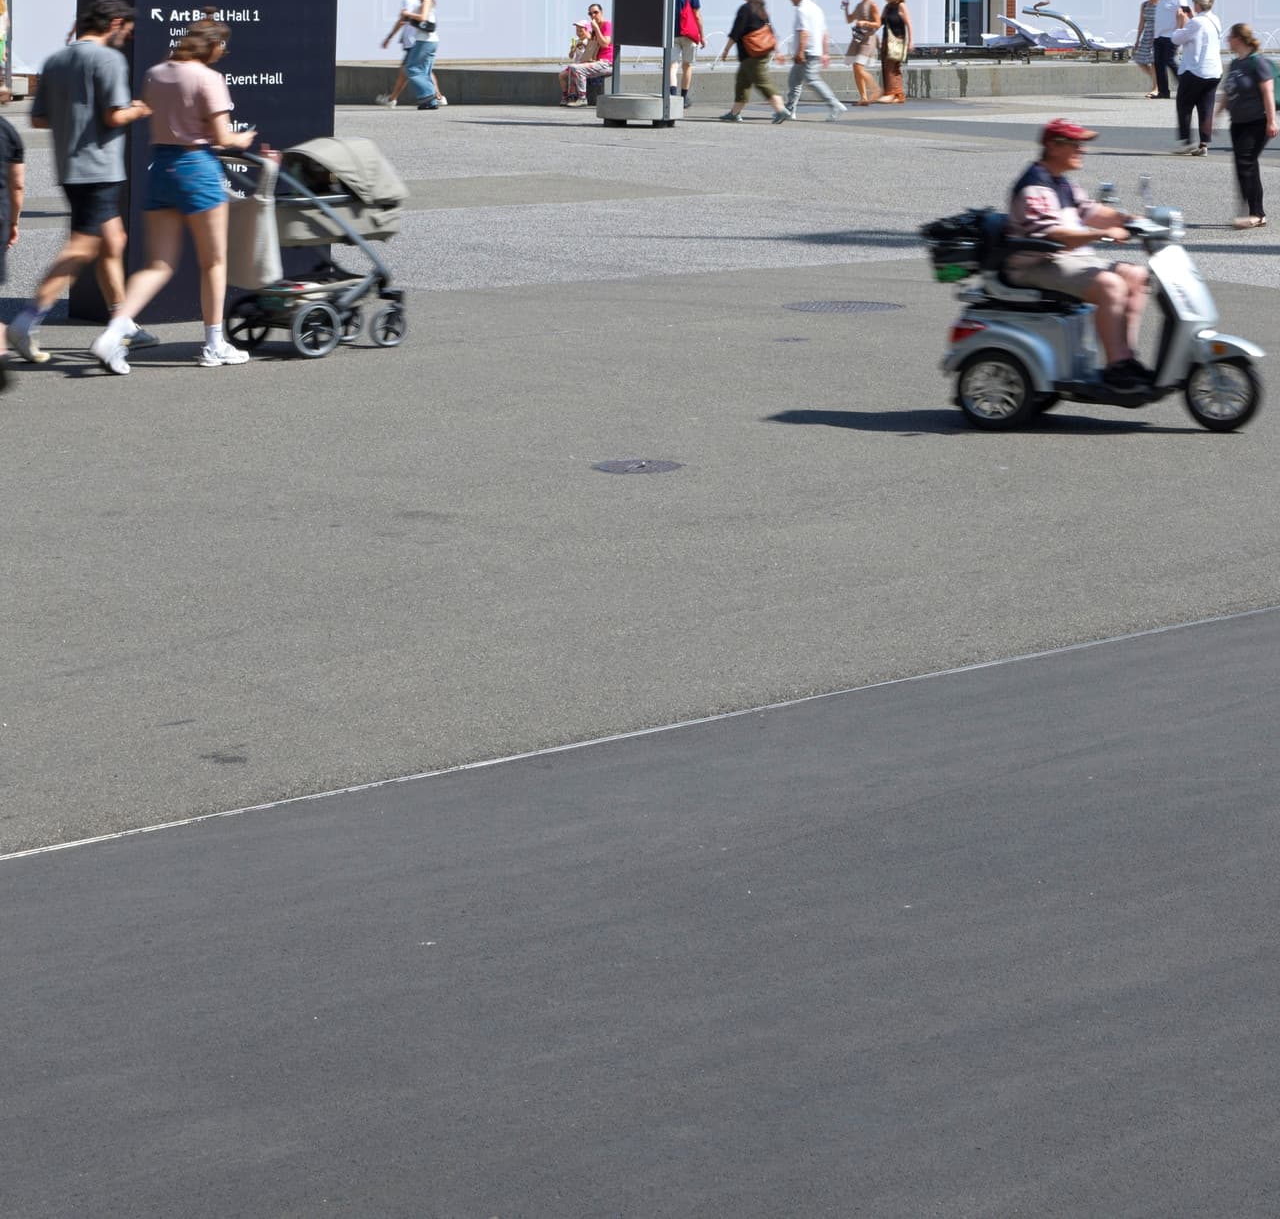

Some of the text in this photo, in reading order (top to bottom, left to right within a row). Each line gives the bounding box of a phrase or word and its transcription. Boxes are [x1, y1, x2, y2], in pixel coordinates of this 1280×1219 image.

[170, 10, 260, 22] Art Bael Hall 1
[225, 72, 283, 85] Event Hall
